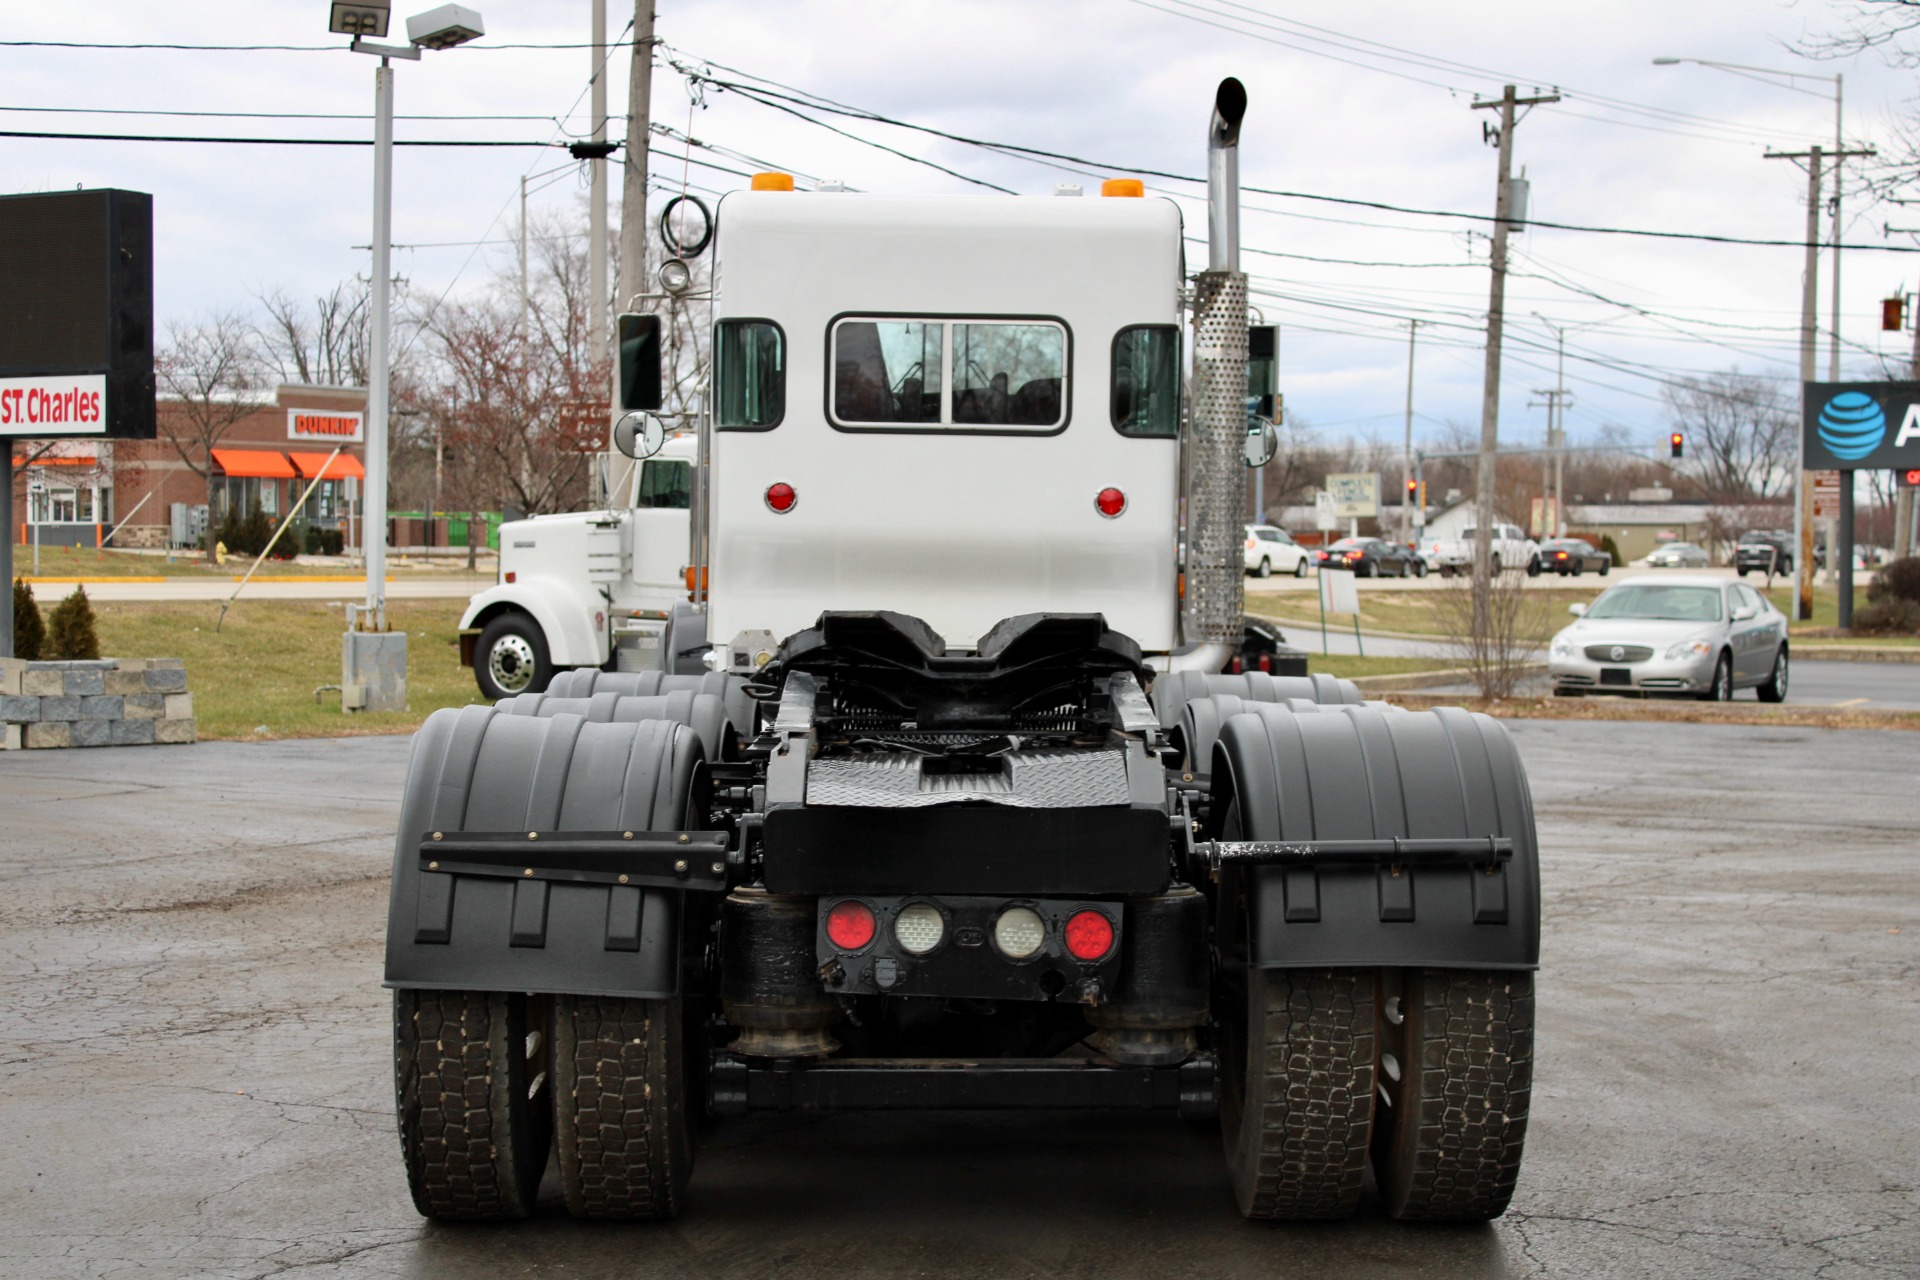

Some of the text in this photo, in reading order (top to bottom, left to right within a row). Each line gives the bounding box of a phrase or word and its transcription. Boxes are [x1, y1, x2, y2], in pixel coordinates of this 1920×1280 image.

[2, 387, 99, 424] ST. Charles
[295, 414, 359, 436] DUNKIN'
